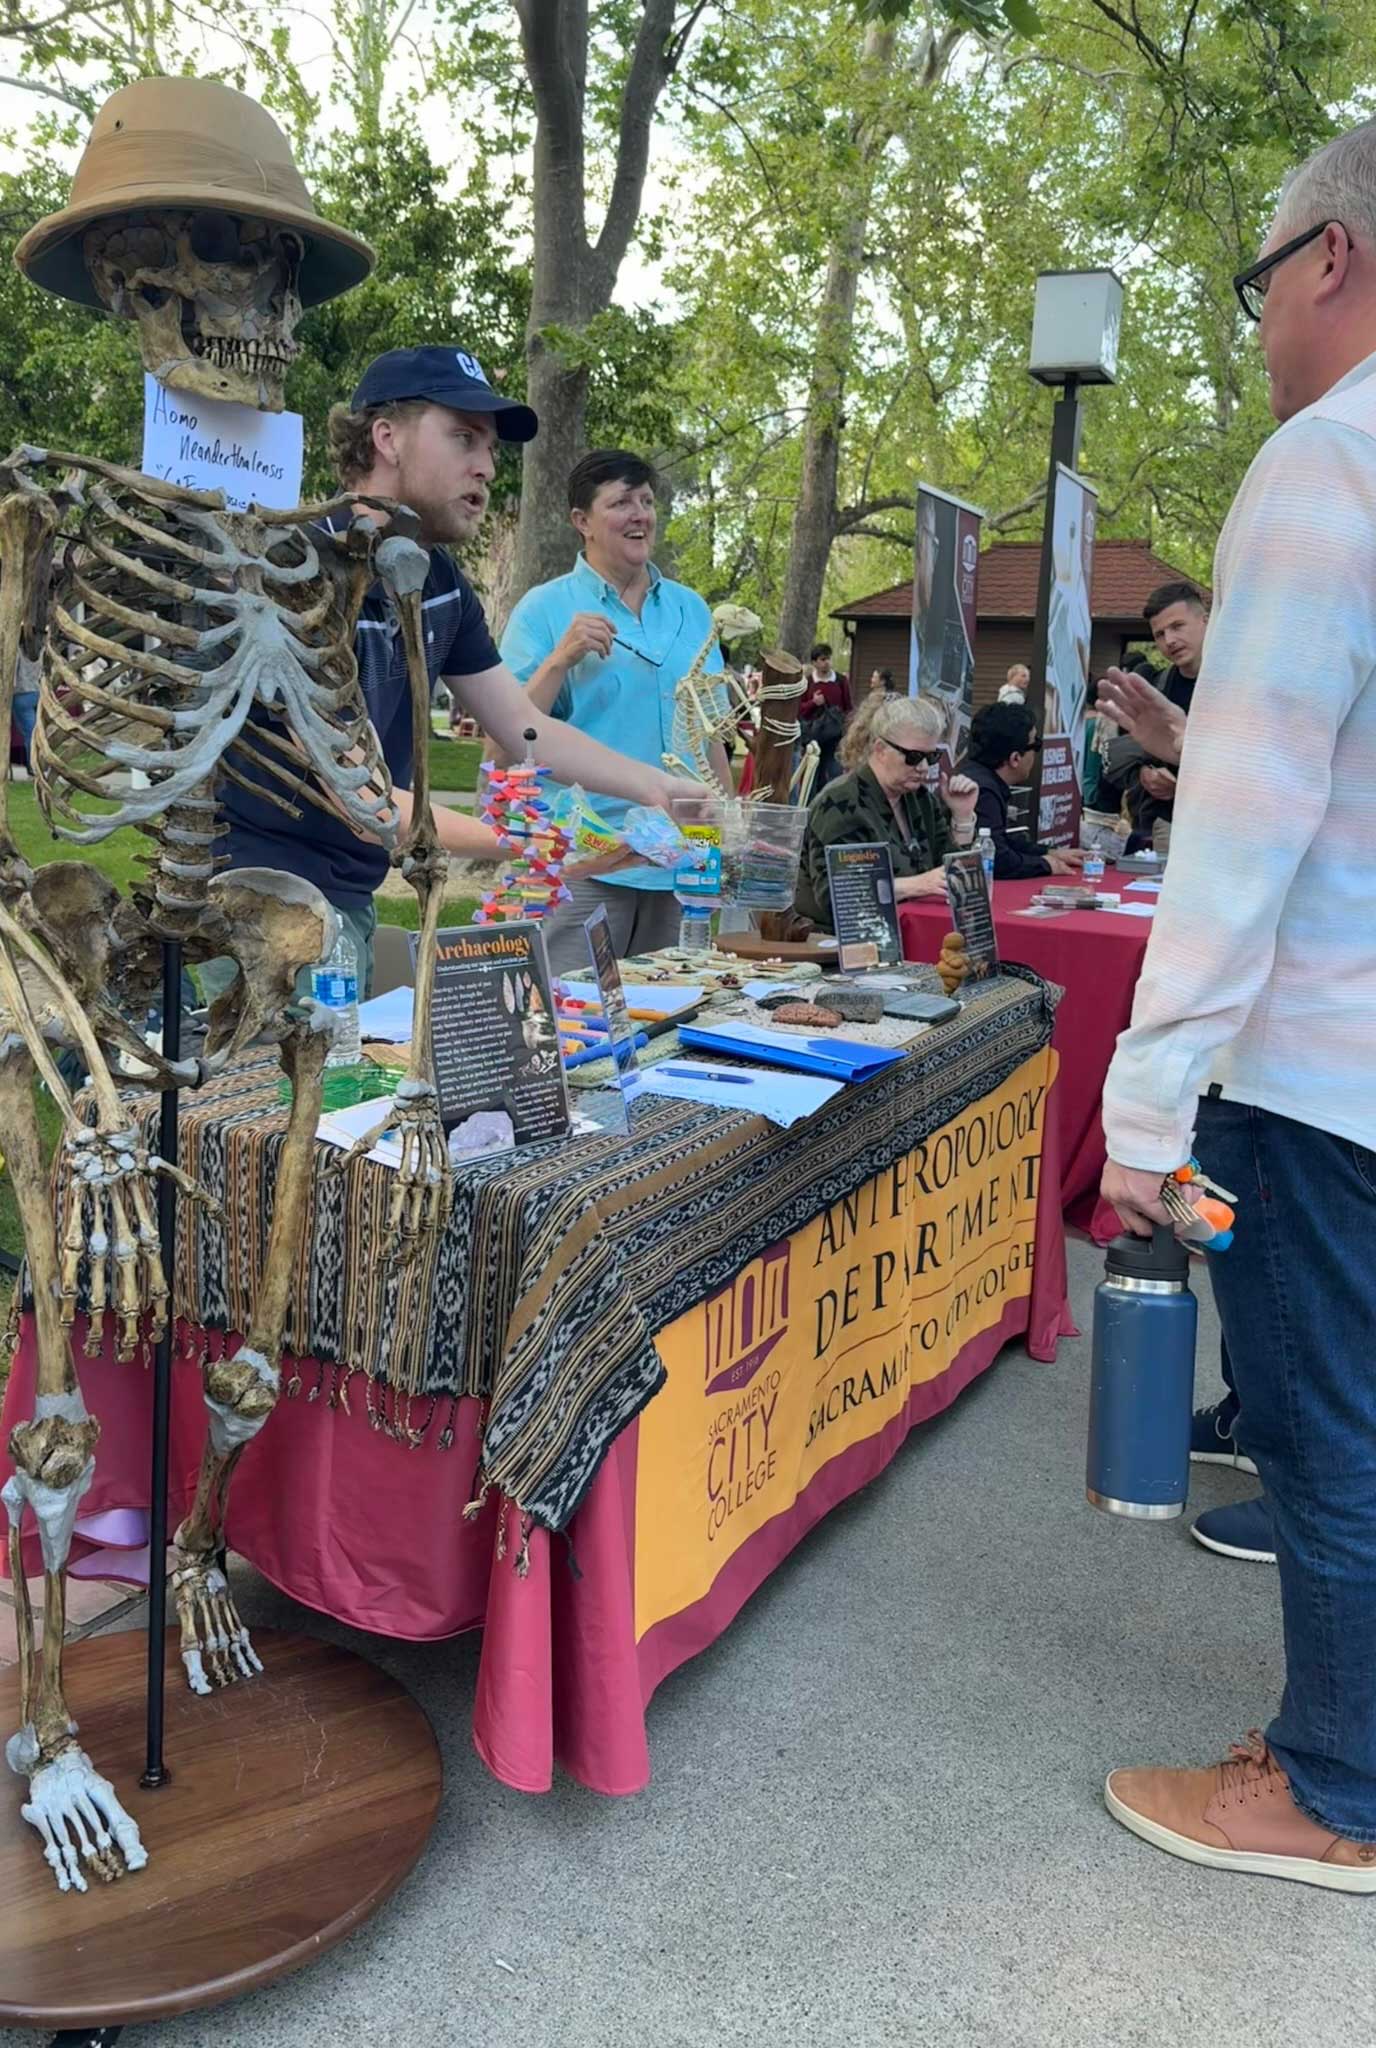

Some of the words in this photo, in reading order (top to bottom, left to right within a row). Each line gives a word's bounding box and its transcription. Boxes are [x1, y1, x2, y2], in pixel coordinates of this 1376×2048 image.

[435, 933, 530, 960] Archaeology
[812, 1086, 1045, 1268] ANTHROPOLOGY
[708, 1370, 781, 1446] SACRAMENTO
[805, 1319, 938, 1448] SACRAMTO
[707, 1391, 778, 1502] CITY
[707, 1450, 777, 1542] COLLEGE
